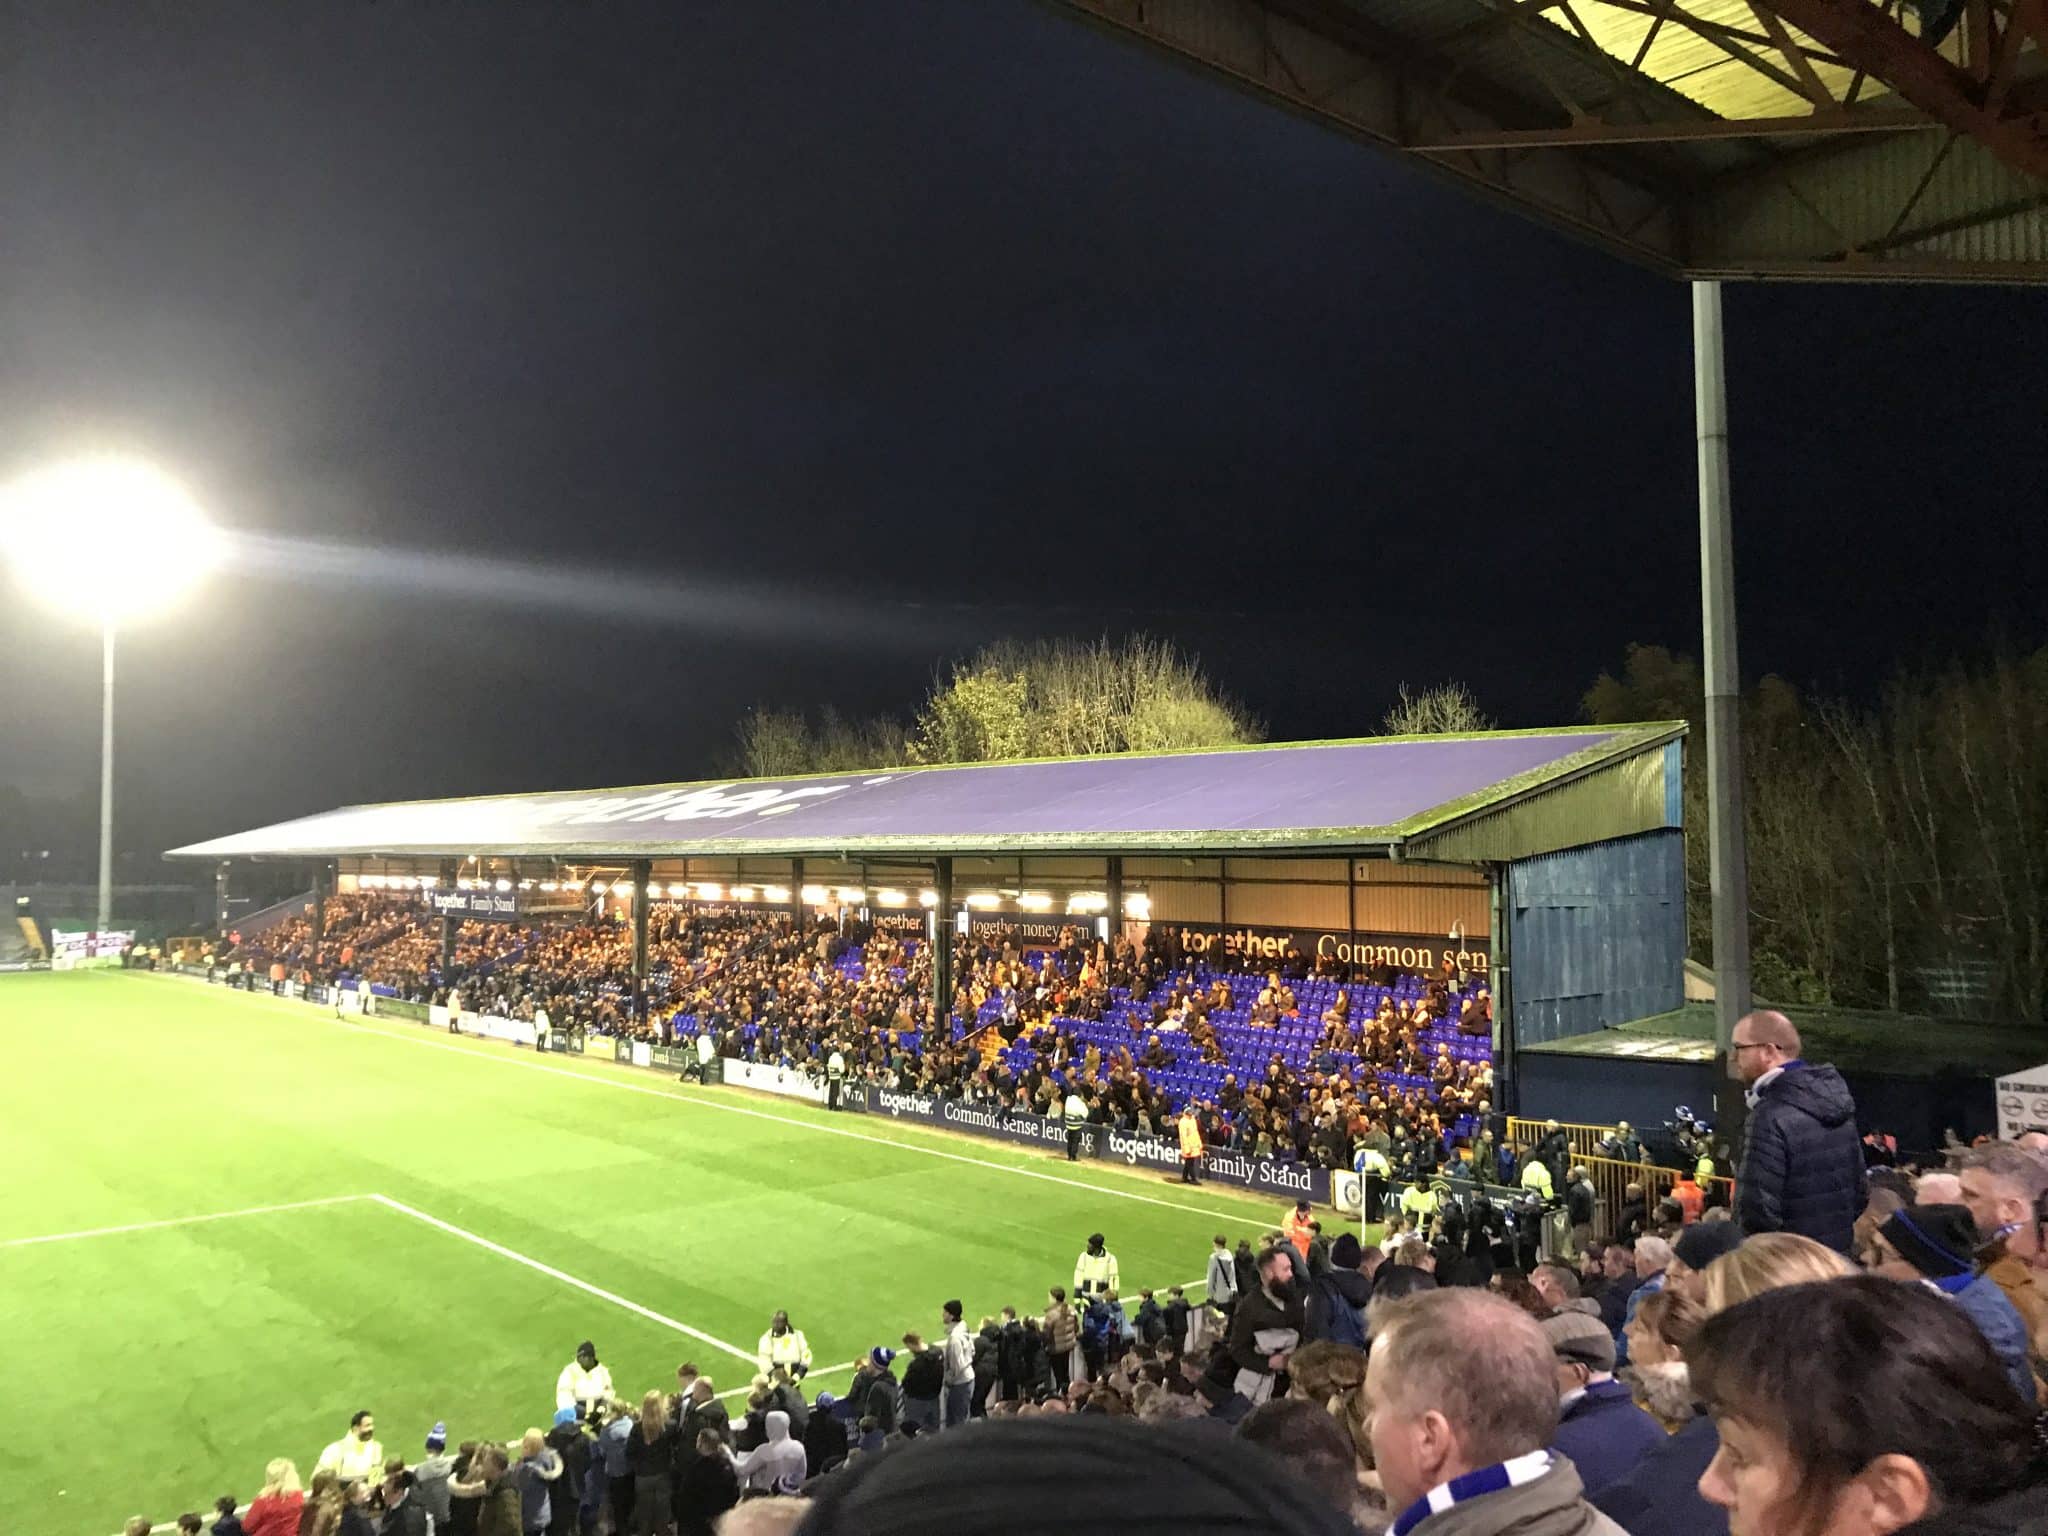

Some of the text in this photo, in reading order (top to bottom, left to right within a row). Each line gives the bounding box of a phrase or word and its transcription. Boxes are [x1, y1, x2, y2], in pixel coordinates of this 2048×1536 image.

[471, 895, 492, 915] Family
[495, 895, 515, 912] Stand
[1318, 935, 1434, 969] Common
[1443, 950, 1488, 973] sen
[880, 1090, 934, 1116] together.
[1003, 1116, 1038, 1137] sense
[1042, 1119, 1094, 1153] lenng
[1200, 1150, 1256, 1184] Family
[1259, 1161, 1312, 1191] Stand
